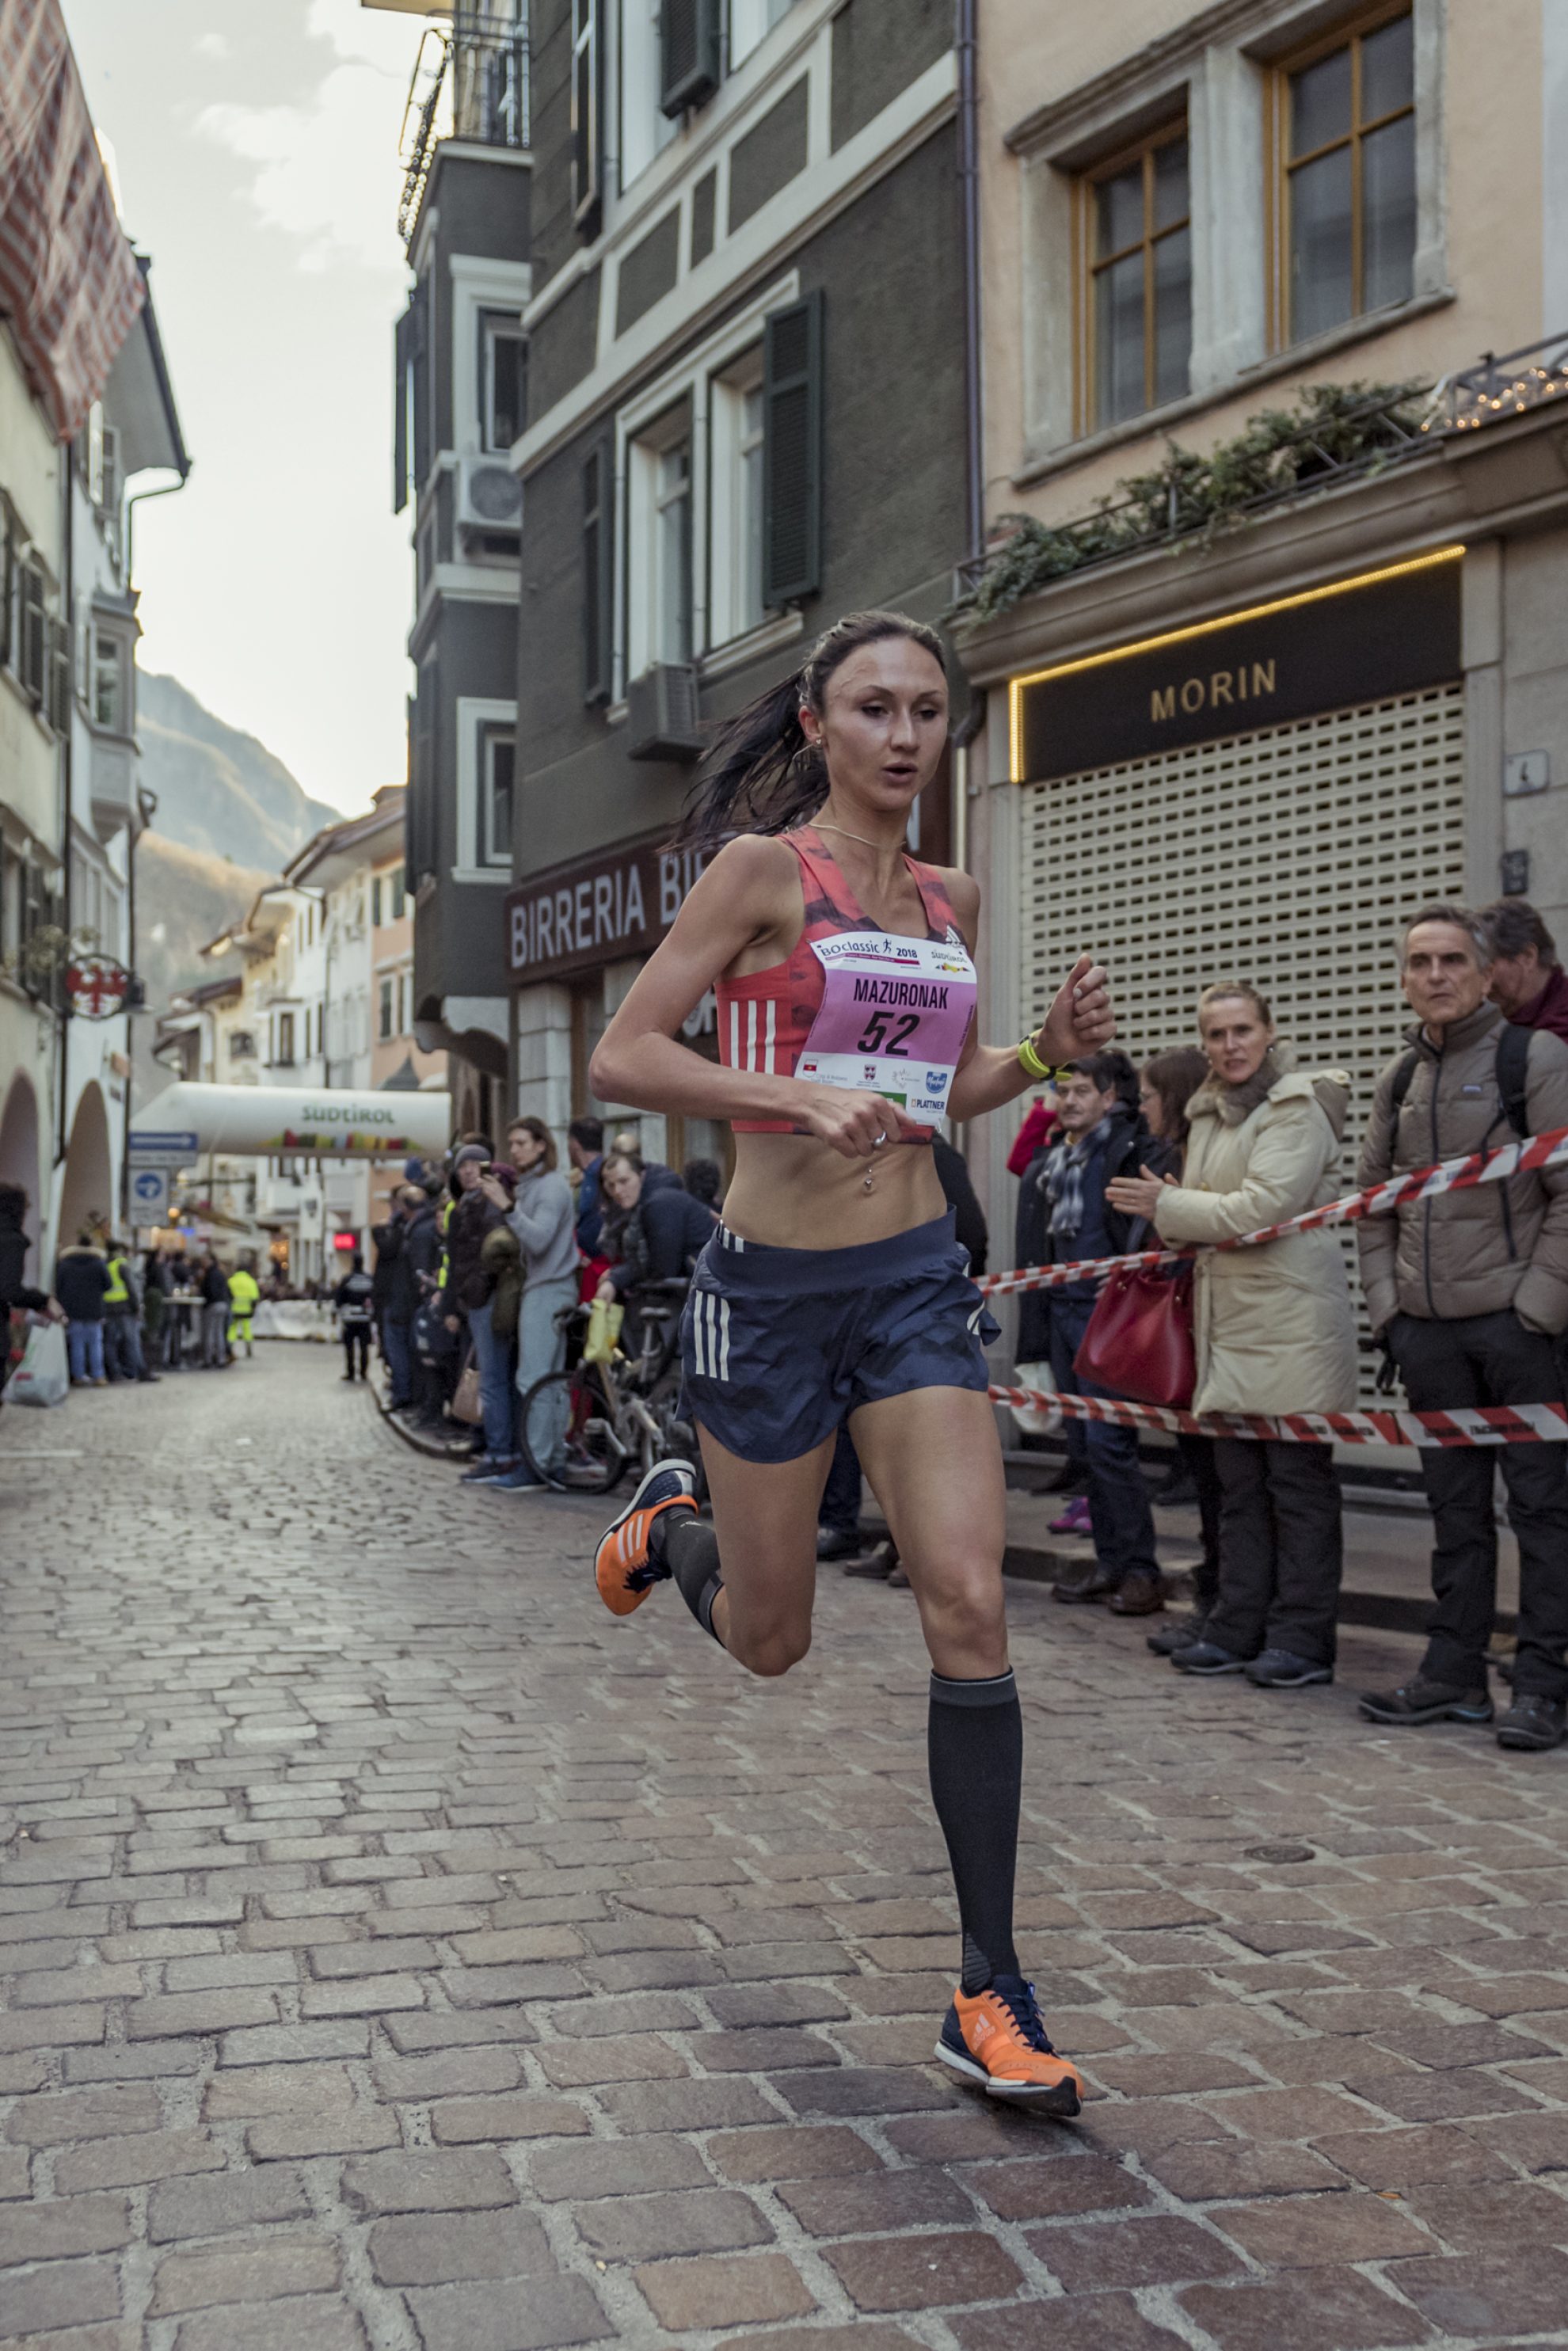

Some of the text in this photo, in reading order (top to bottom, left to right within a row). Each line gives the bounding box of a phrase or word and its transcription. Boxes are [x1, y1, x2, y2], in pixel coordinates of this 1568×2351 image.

[1151, 658, 1276, 722] MORIN
[511, 864, 646, 968] BIRRERIA
[896, 947, 918, 958] 2018
[853, 978, 950, 1010] MAZURONAK
[857, 1010, 920, 1056] 52
[916, 1098, 945, 1110] PLATTNER
